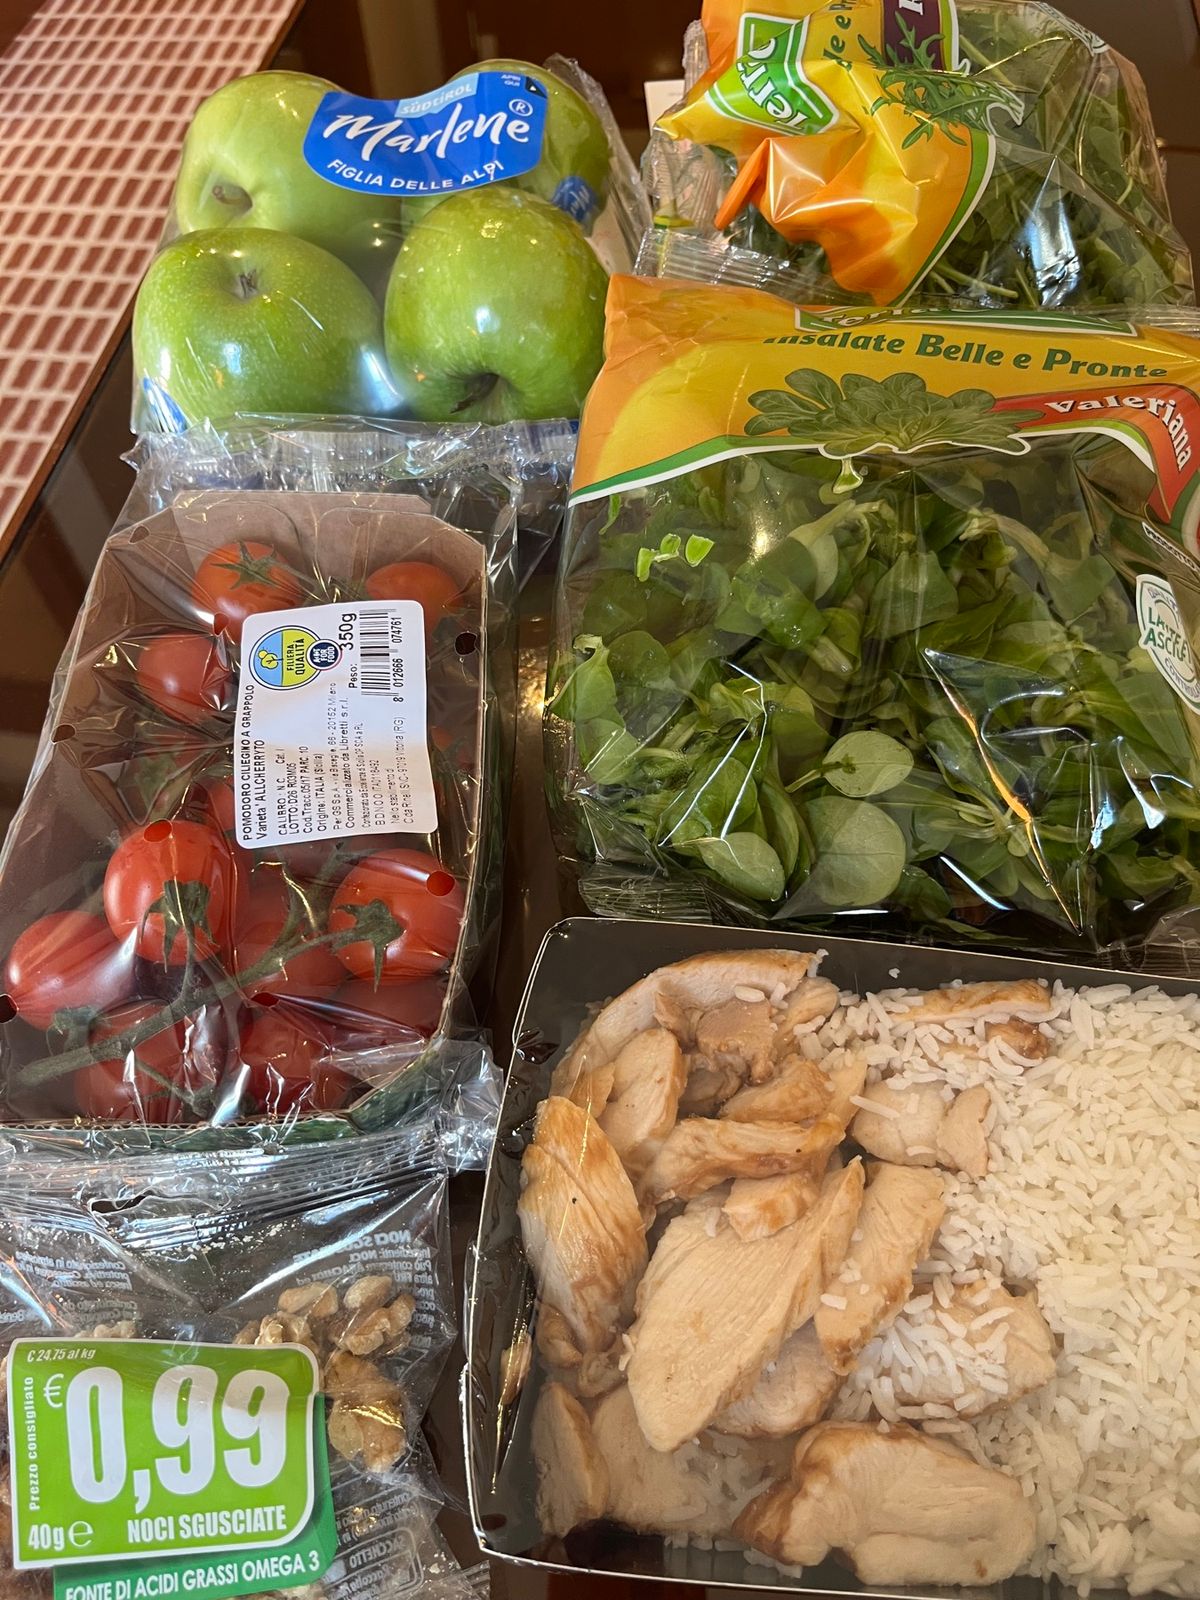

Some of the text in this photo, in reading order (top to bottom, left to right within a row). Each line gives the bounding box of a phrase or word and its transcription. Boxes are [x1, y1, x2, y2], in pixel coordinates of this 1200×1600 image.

[327, 158, 504, 191] FIGLIA DELLE ALPI
[916, 333, 1004, 366] Belle
[1013, 352, 1032, 370] e
[1042, 348, 1168, 378] Pronte
[1044, 394, 1192, 471] Valeriana
[338, 613, 357, 651] 350g
[390, 617, 402, 644] 074761
[286, 643, 295, 671] FILIERA
[294, 638, 305, 676] QUALITÀ
[320, 648, 328, 662] FOR
[327, 646, 336, 663] FOOD
[348, 664, 358, 689] Peso:
[392, 658, 404, 688] 012666
[241, 685, 255, 728] GRAPPOLO
[338, 720, 349, 751] Libretti
[393, 716, 407, 735] (RG)
[241, 739, 251, 780] CILIEGINO
[298, 746, 309, 754] 10
[341, 752, 350, 762] da
[253, 740, 266, 802] ALLCHERRYTO
[314, 776, 326, 799] ITALIA
[343, 763, 355, 829] Commercializzato
[241, 783, 253, 840] POMODORO
[317, 800, 329, 832] Origine:
[333, 818, 342, 830] Per
[67, 1348, 81, 1360] al
[81, 1347, 97, 1360] kg
[24, 1377, 40, 1511] Prezzo consigliato
[43, 1364, 290, 1514] € 0,99
[28, 1523, 65, 1552] 40g
[127, 1504, 287, 1544] NOCI SGUSCIATE
[65, 1550, 320, 1600] FONTE DI ACIDI GRASSI OMEGA 3
